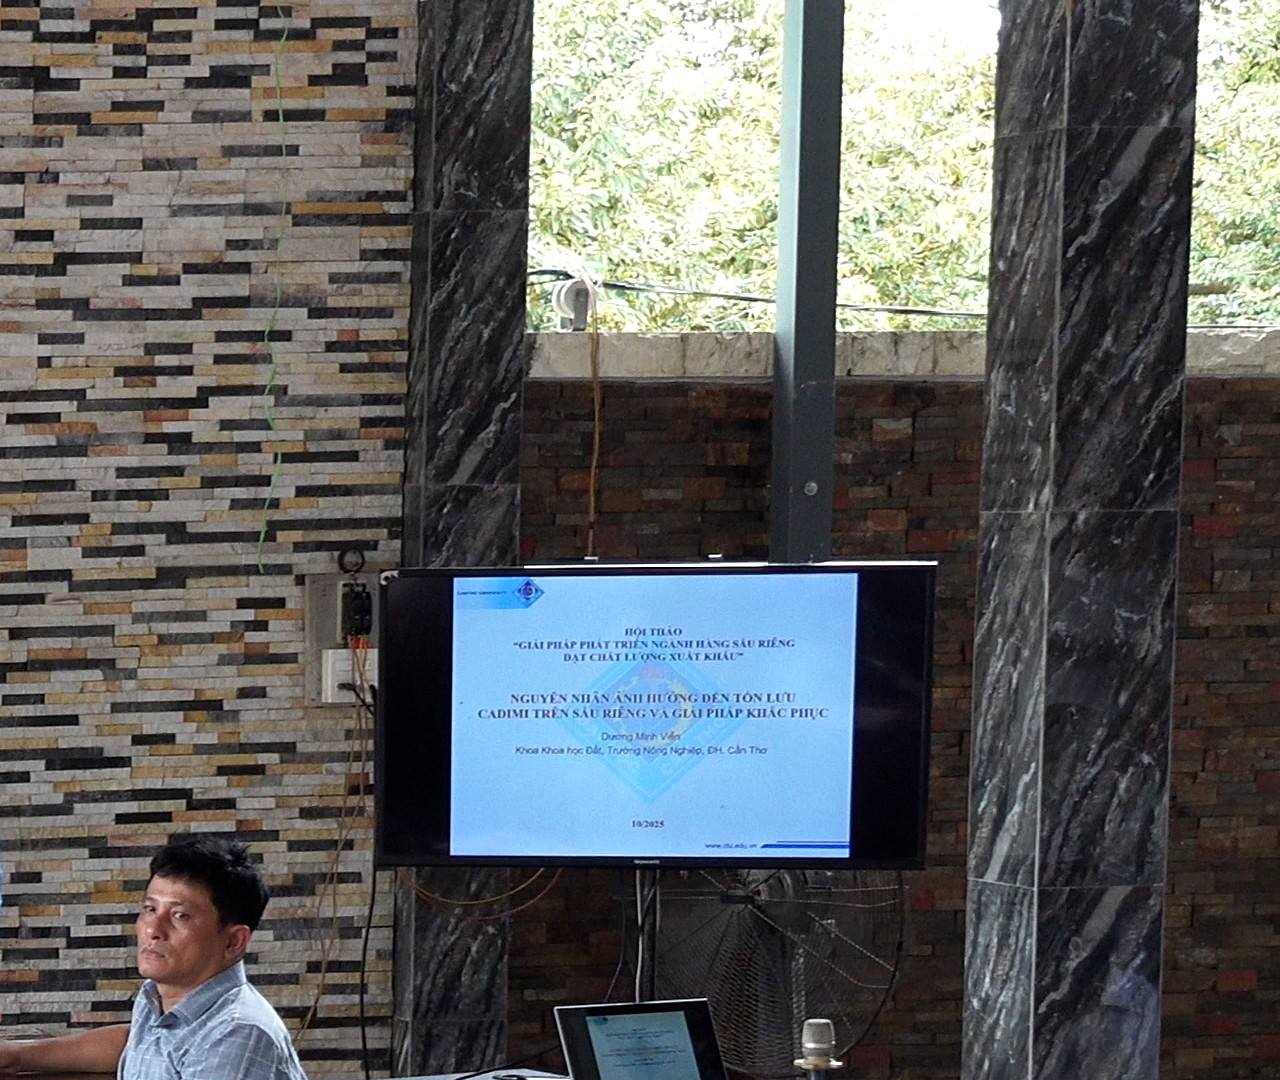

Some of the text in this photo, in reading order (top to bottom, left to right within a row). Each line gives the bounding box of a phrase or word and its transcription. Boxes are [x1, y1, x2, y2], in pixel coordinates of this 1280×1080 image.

[478, 708, 529, 719] CADIMI
[636, 731, 658, 741] Minh
[515, 745, 539, 755] Khoa
[541, 745, 565, 755] Khoa
